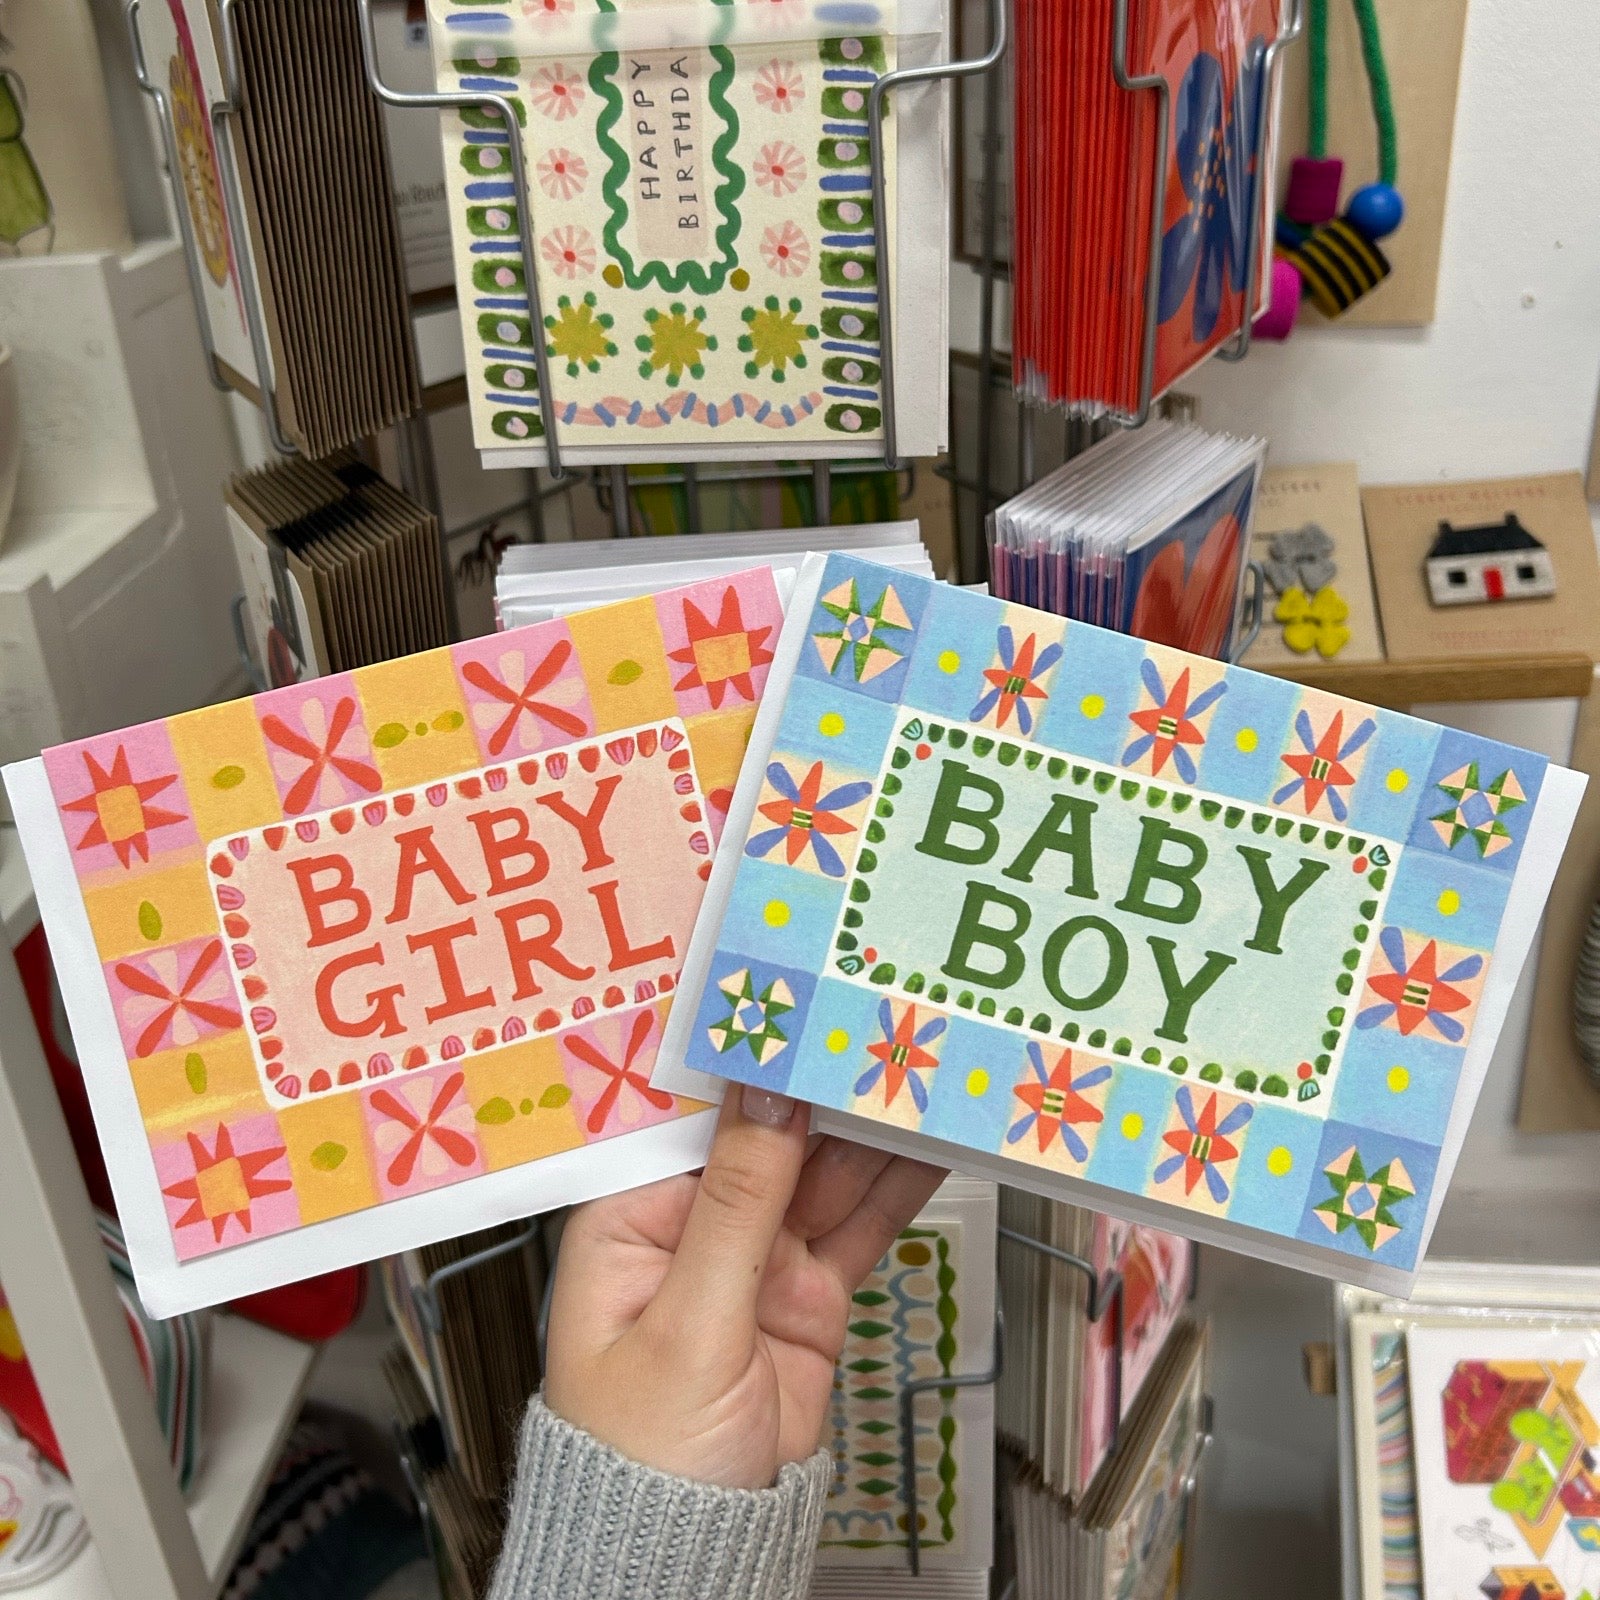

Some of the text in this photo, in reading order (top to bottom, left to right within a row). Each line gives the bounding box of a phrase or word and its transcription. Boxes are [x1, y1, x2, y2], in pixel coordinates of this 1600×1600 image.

[630, 59, 661, 199] HAPPY
[670, 48, 699, 228] BIRTHDA
[288, 776, 622, 947] BABY
[914, 759, 1328, 954] BABY
[315, 880, 675, 1037] GIRL
[941, 881, 1237, 1043] BOY
